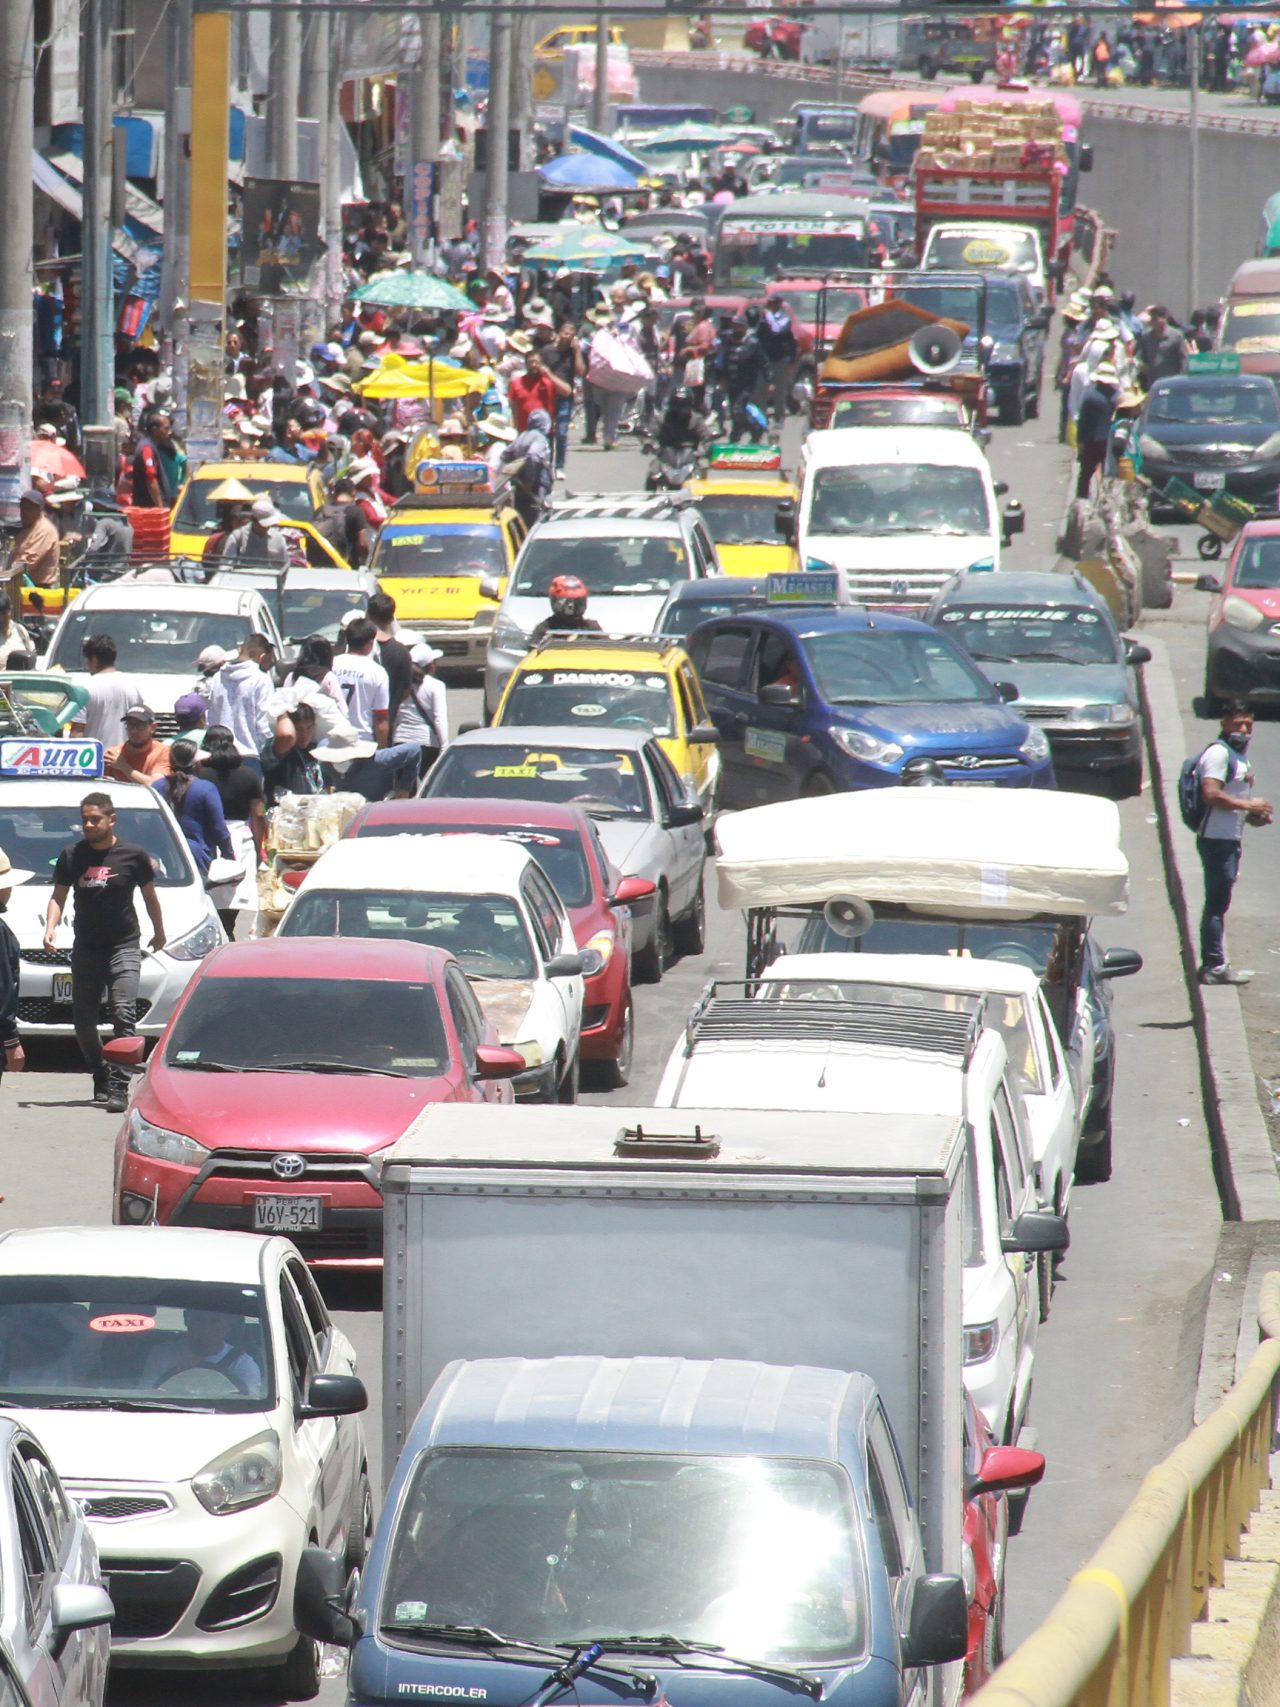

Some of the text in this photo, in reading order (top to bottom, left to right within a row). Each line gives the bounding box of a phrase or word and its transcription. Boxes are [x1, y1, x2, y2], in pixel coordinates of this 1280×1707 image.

[553, 673, 636, 687] DAEWOO
[341, 683, 356, 706] 7
[499, 768, 532, 776] TAXI
[258, 1205, 317, 1225] V6Y-521
[100, 1319, 144, 1327] TAXI
[398, 1683, 488, 1699] INTERCOOLER
